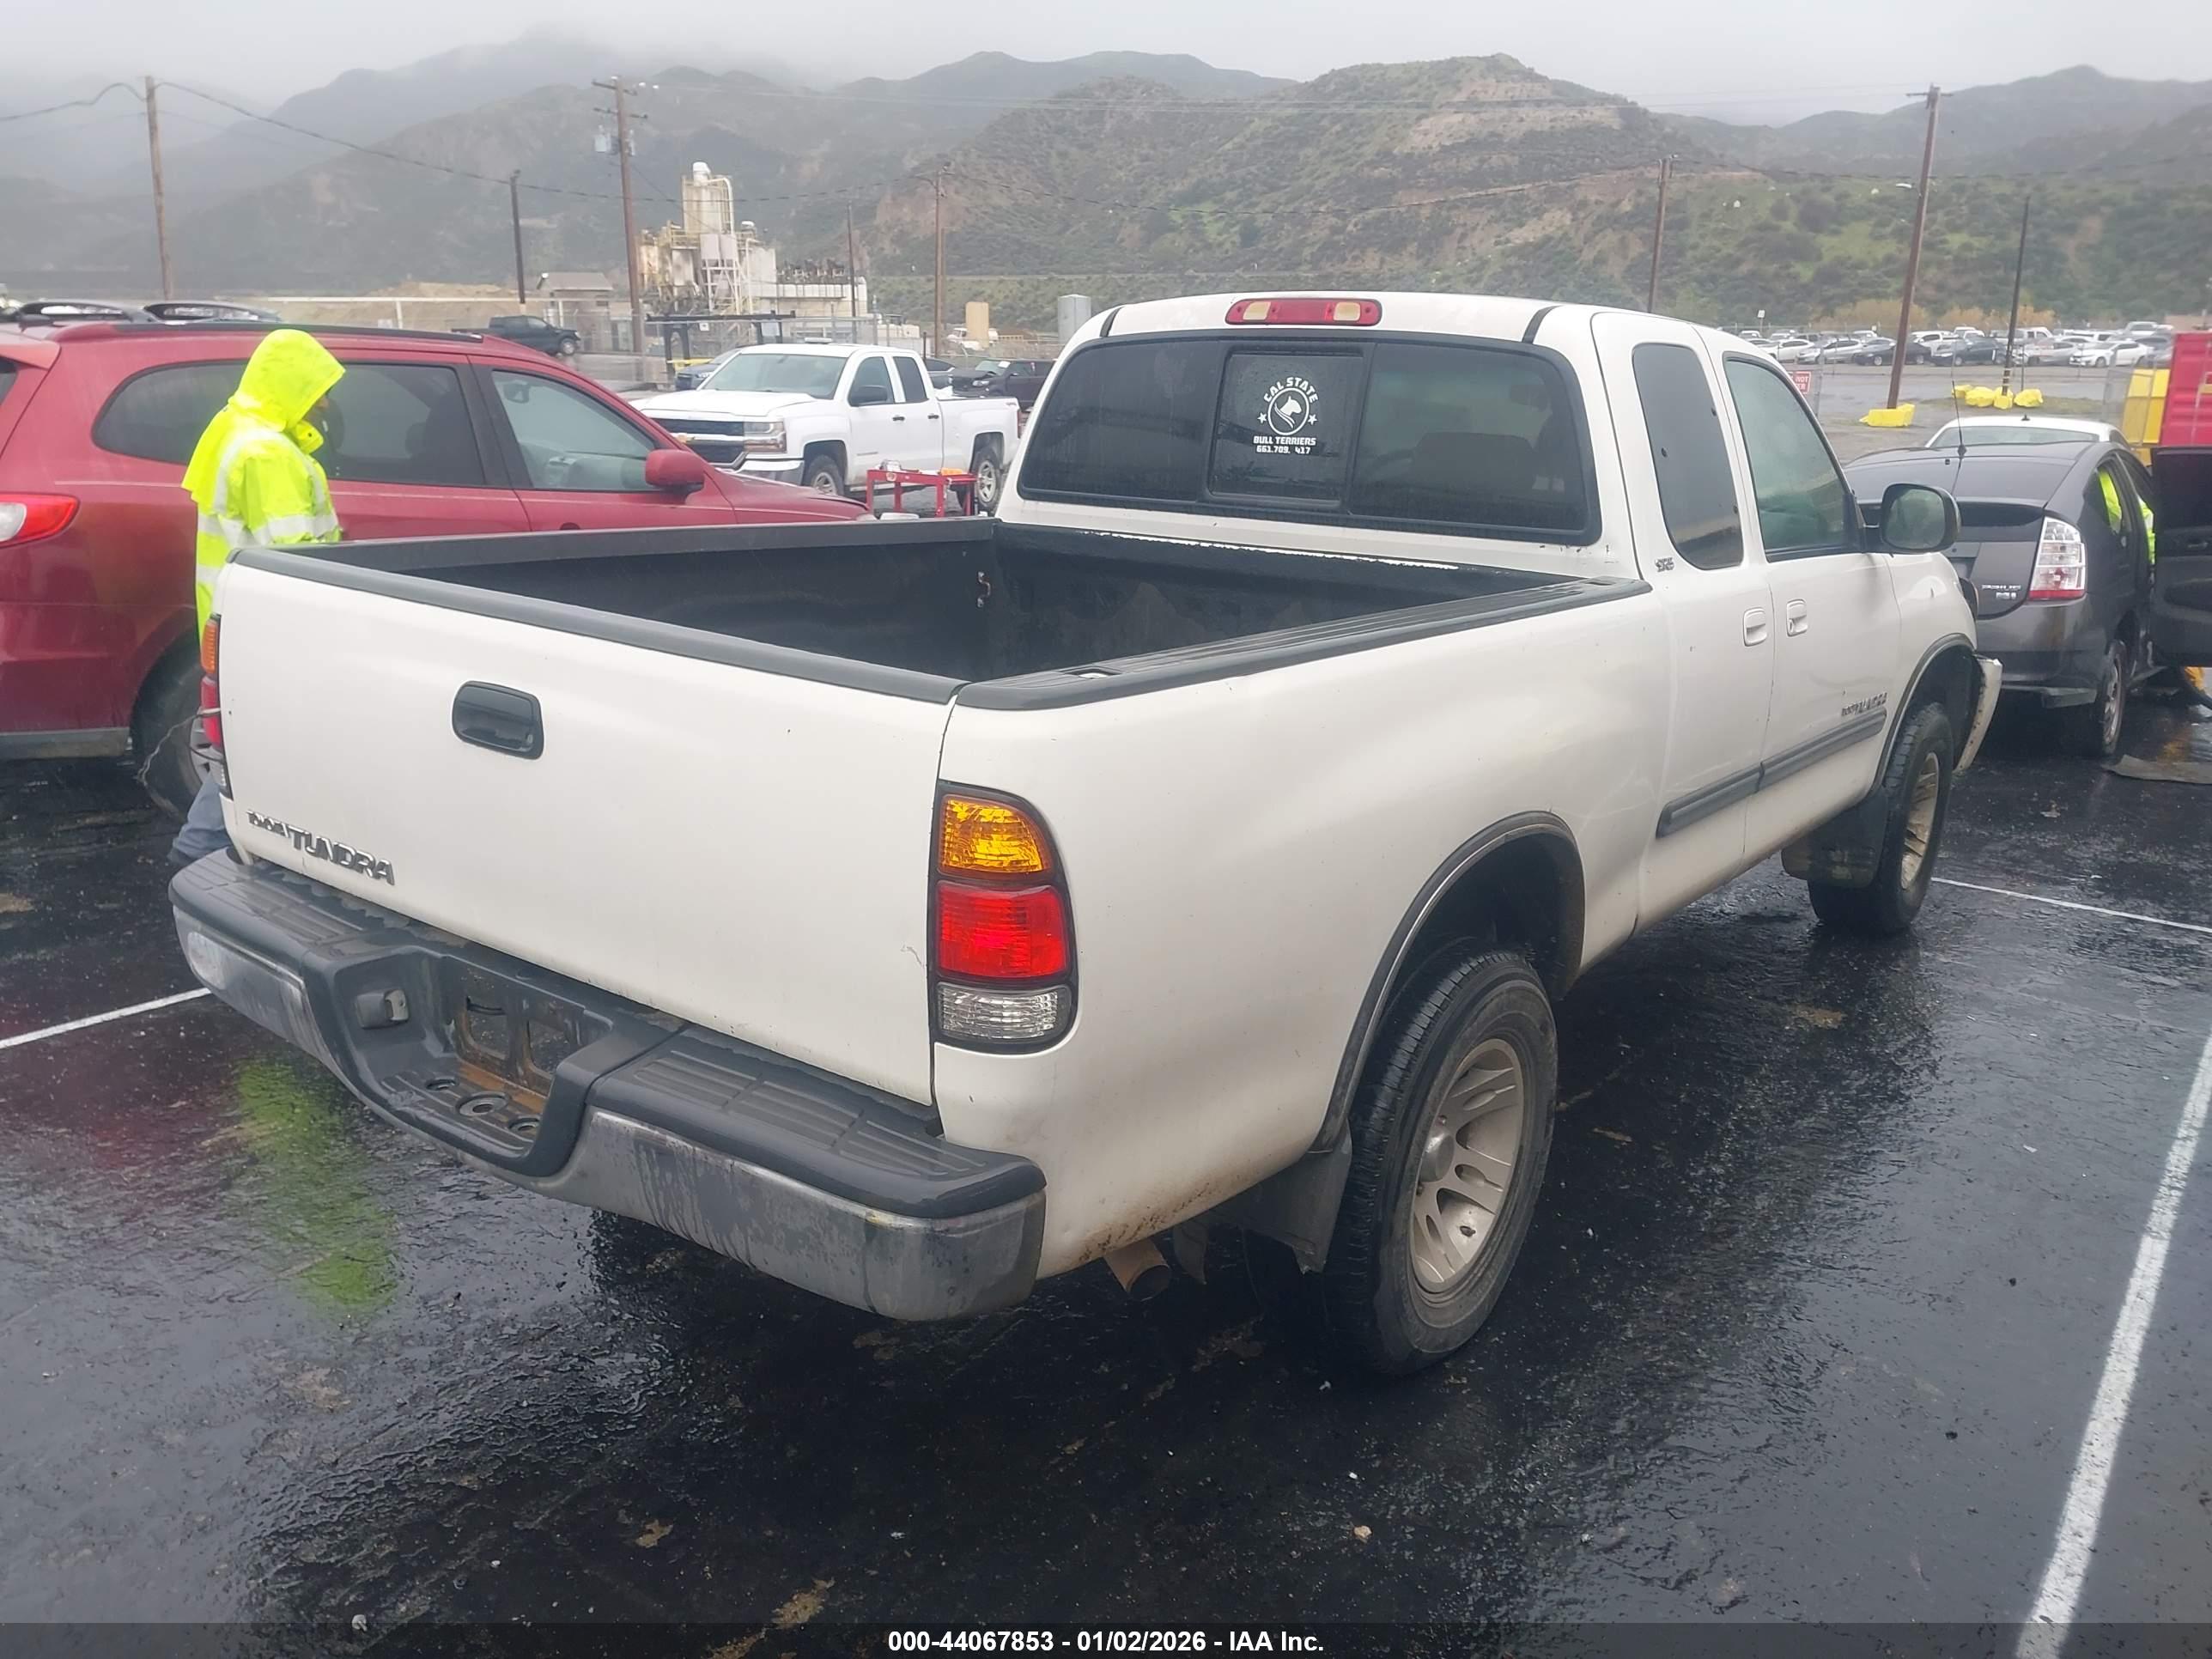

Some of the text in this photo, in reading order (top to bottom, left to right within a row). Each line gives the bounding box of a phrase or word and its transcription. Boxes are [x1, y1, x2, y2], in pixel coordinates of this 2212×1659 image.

[1263, 376, 1319, 404] CAL STATE
[1253, 435, 1317, 446] BULL TERRIERS
[288, 824, 396, 886] TUNDRA
